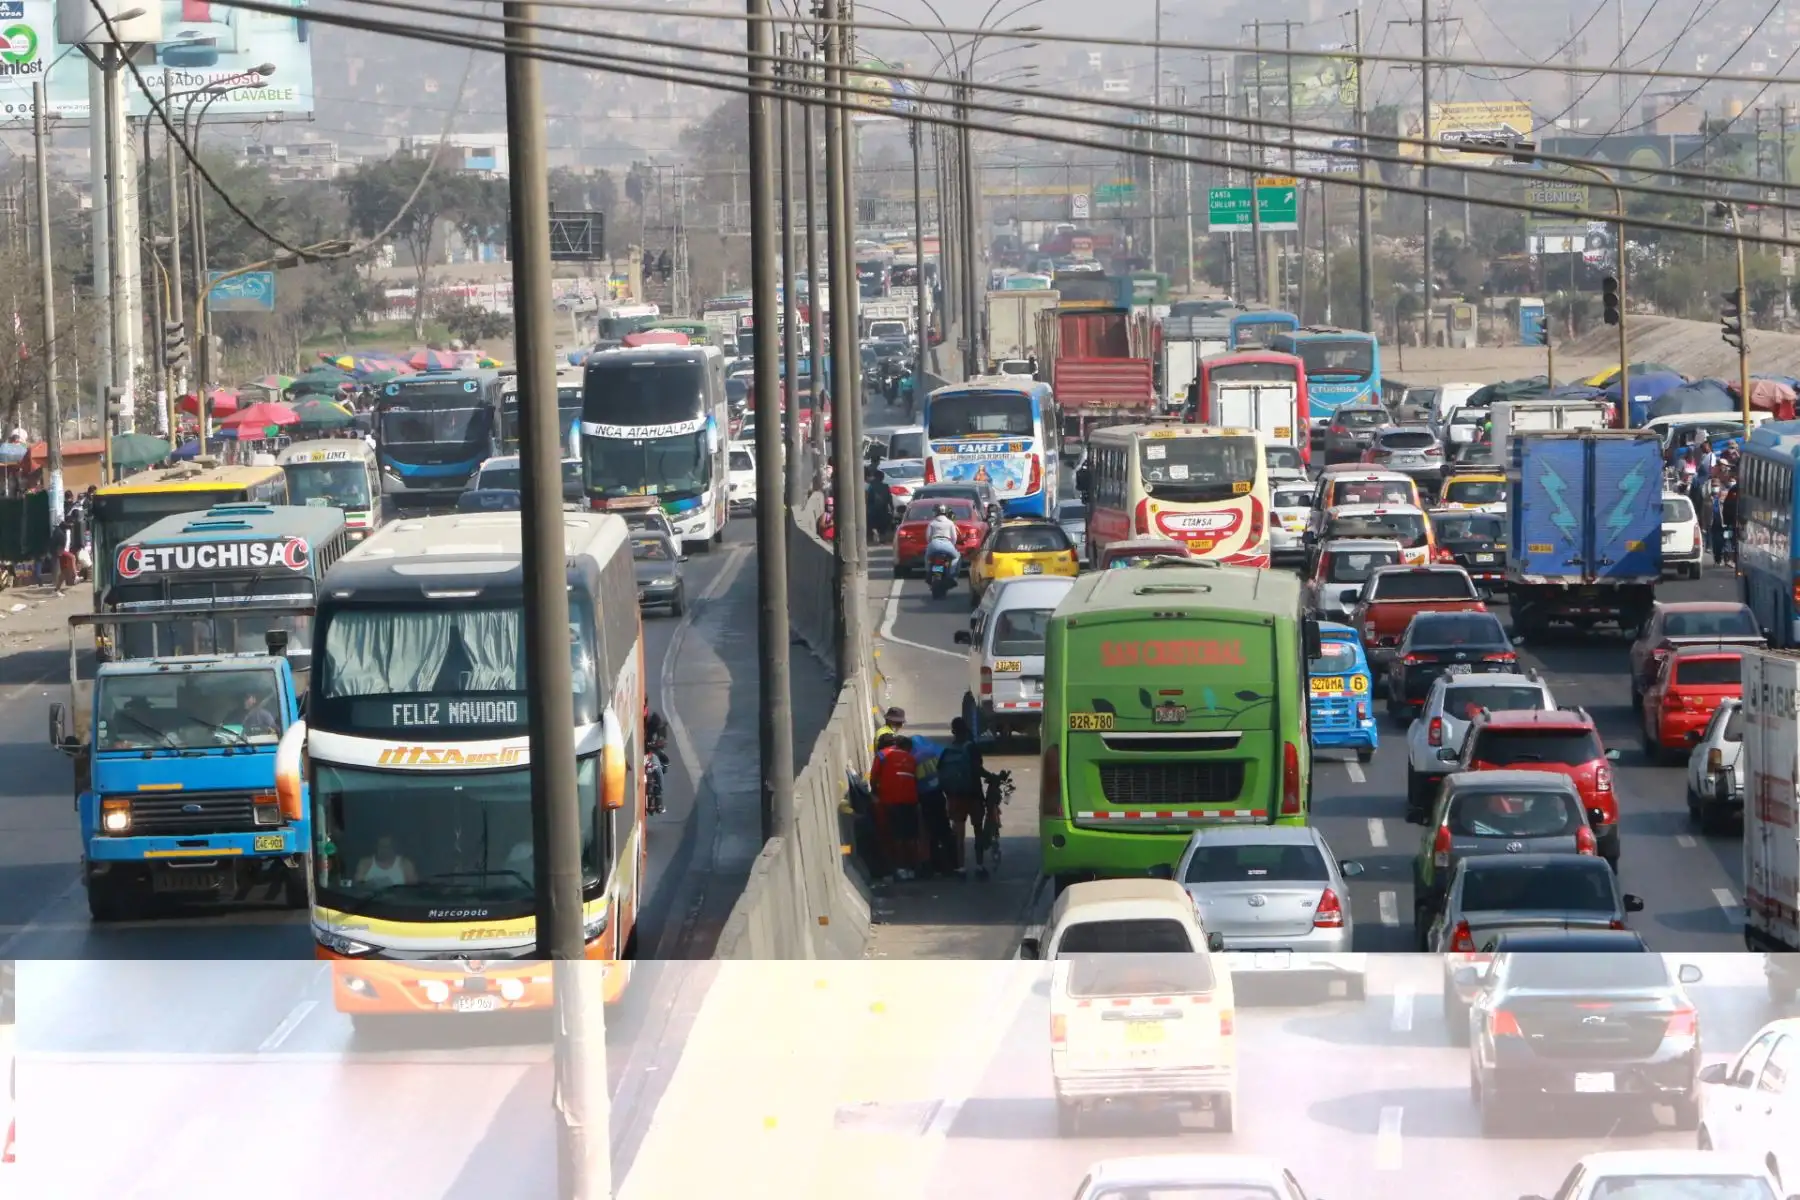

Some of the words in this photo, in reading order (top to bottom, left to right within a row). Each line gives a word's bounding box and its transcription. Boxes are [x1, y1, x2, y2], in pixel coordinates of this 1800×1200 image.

[233, 89, 293, 101] LAVABLE
[595, 426, 622, 437] INCA
[627, 422, 696, 437] ATAHUALPA
[958, 443, 1005, 453] FAMET
[1101, 640, 1141, 667] SAN
[392, 703, 440, 726] FELIZ
[448, 700, 517, 724] NAVIDAD
[1070, 715, 1113, 729] B2R-780
[428, 909, 488, 918] Marcopolo
